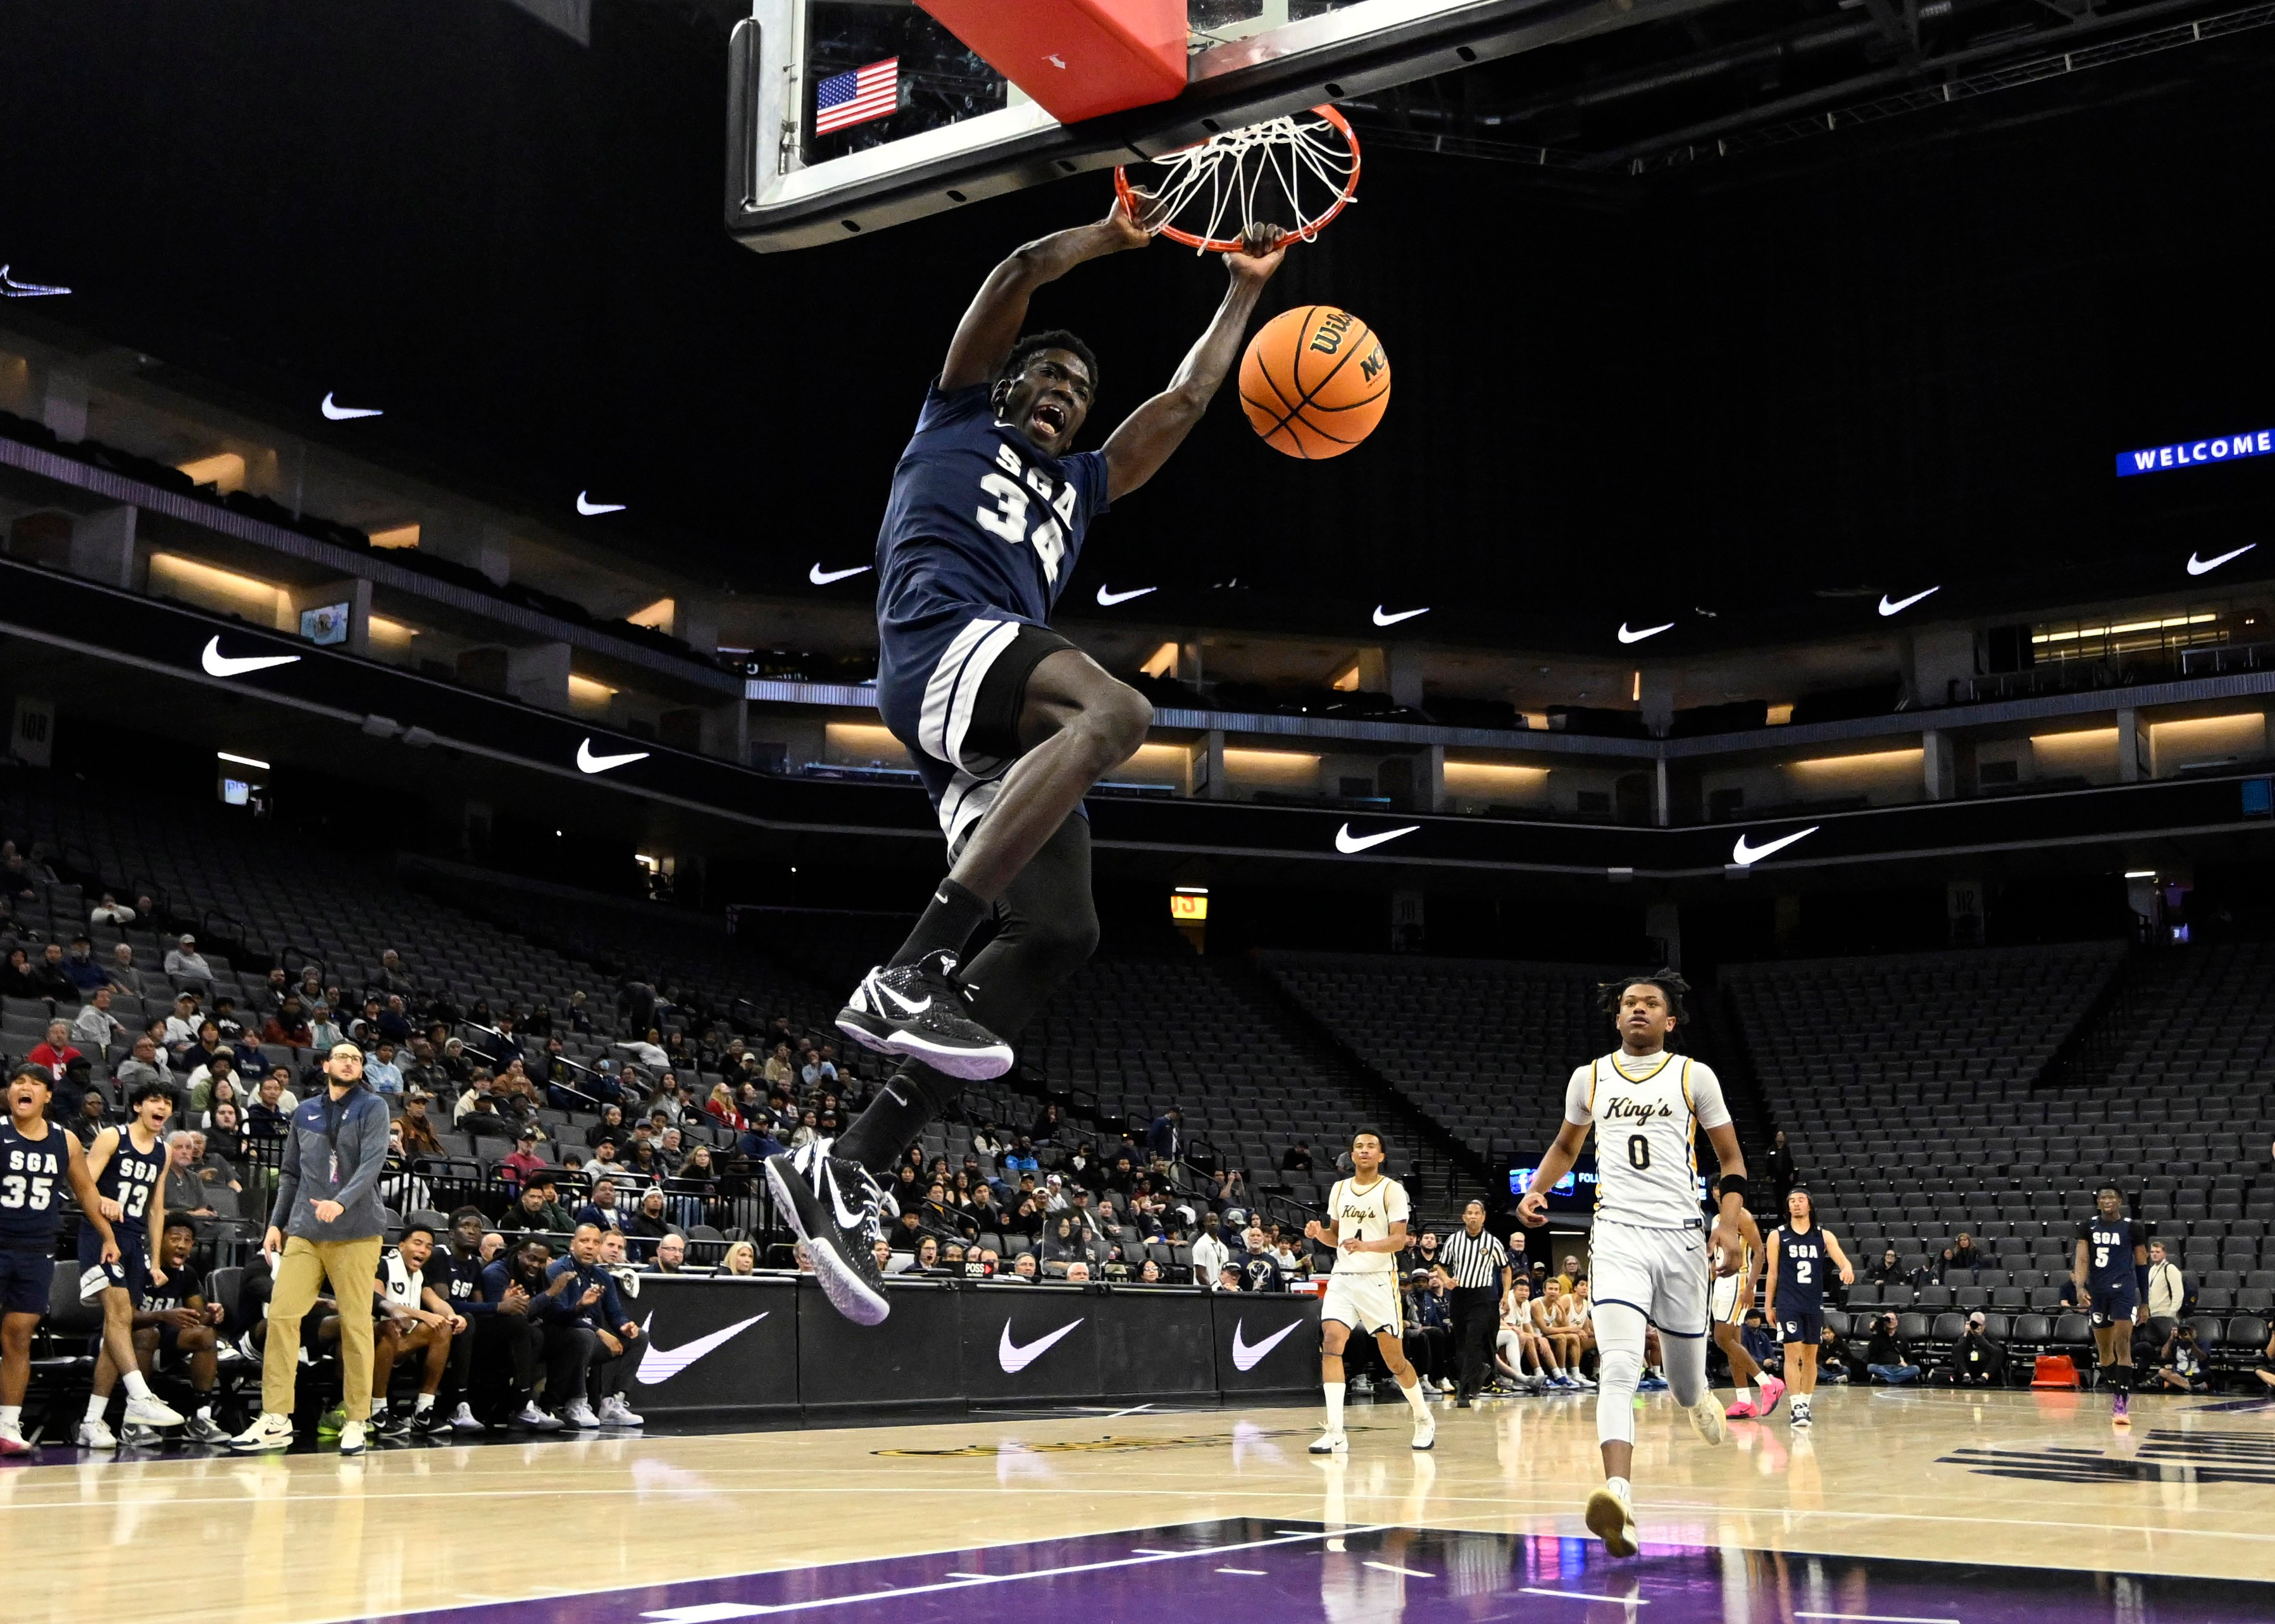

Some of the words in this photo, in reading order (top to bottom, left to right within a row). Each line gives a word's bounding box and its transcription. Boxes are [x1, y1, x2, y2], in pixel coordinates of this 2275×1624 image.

[1360, 344, 1387, 383] NC
[2134, 431, 2271, 470] WELCOME
[995, 443, 1076, 531] SGA
[976, 473, 1065, 588] 34
[1603, 1097, 1673, 1126] King's
[9, 1150, 58, 1174] SGA
[1628, 1134, 1650, 1170] 0
[119, 1158, 158, 1184] SGA
[1578, 1172, 1600, 1183] FOLL
[0, 1175, 54, 1210] 35
[117, 1181, 149, 1218] 13
[1342, 1205, 1376, 1224] King's
[1788, 1244, 1818, 1258] SGA
[2093, 1232, 2121, 1246] SGA
[965, 1263, 985, 1273] POSS
[2095, 1247, 2109, 1268] 5
[1797, 1261, 1812, 1284] 2
